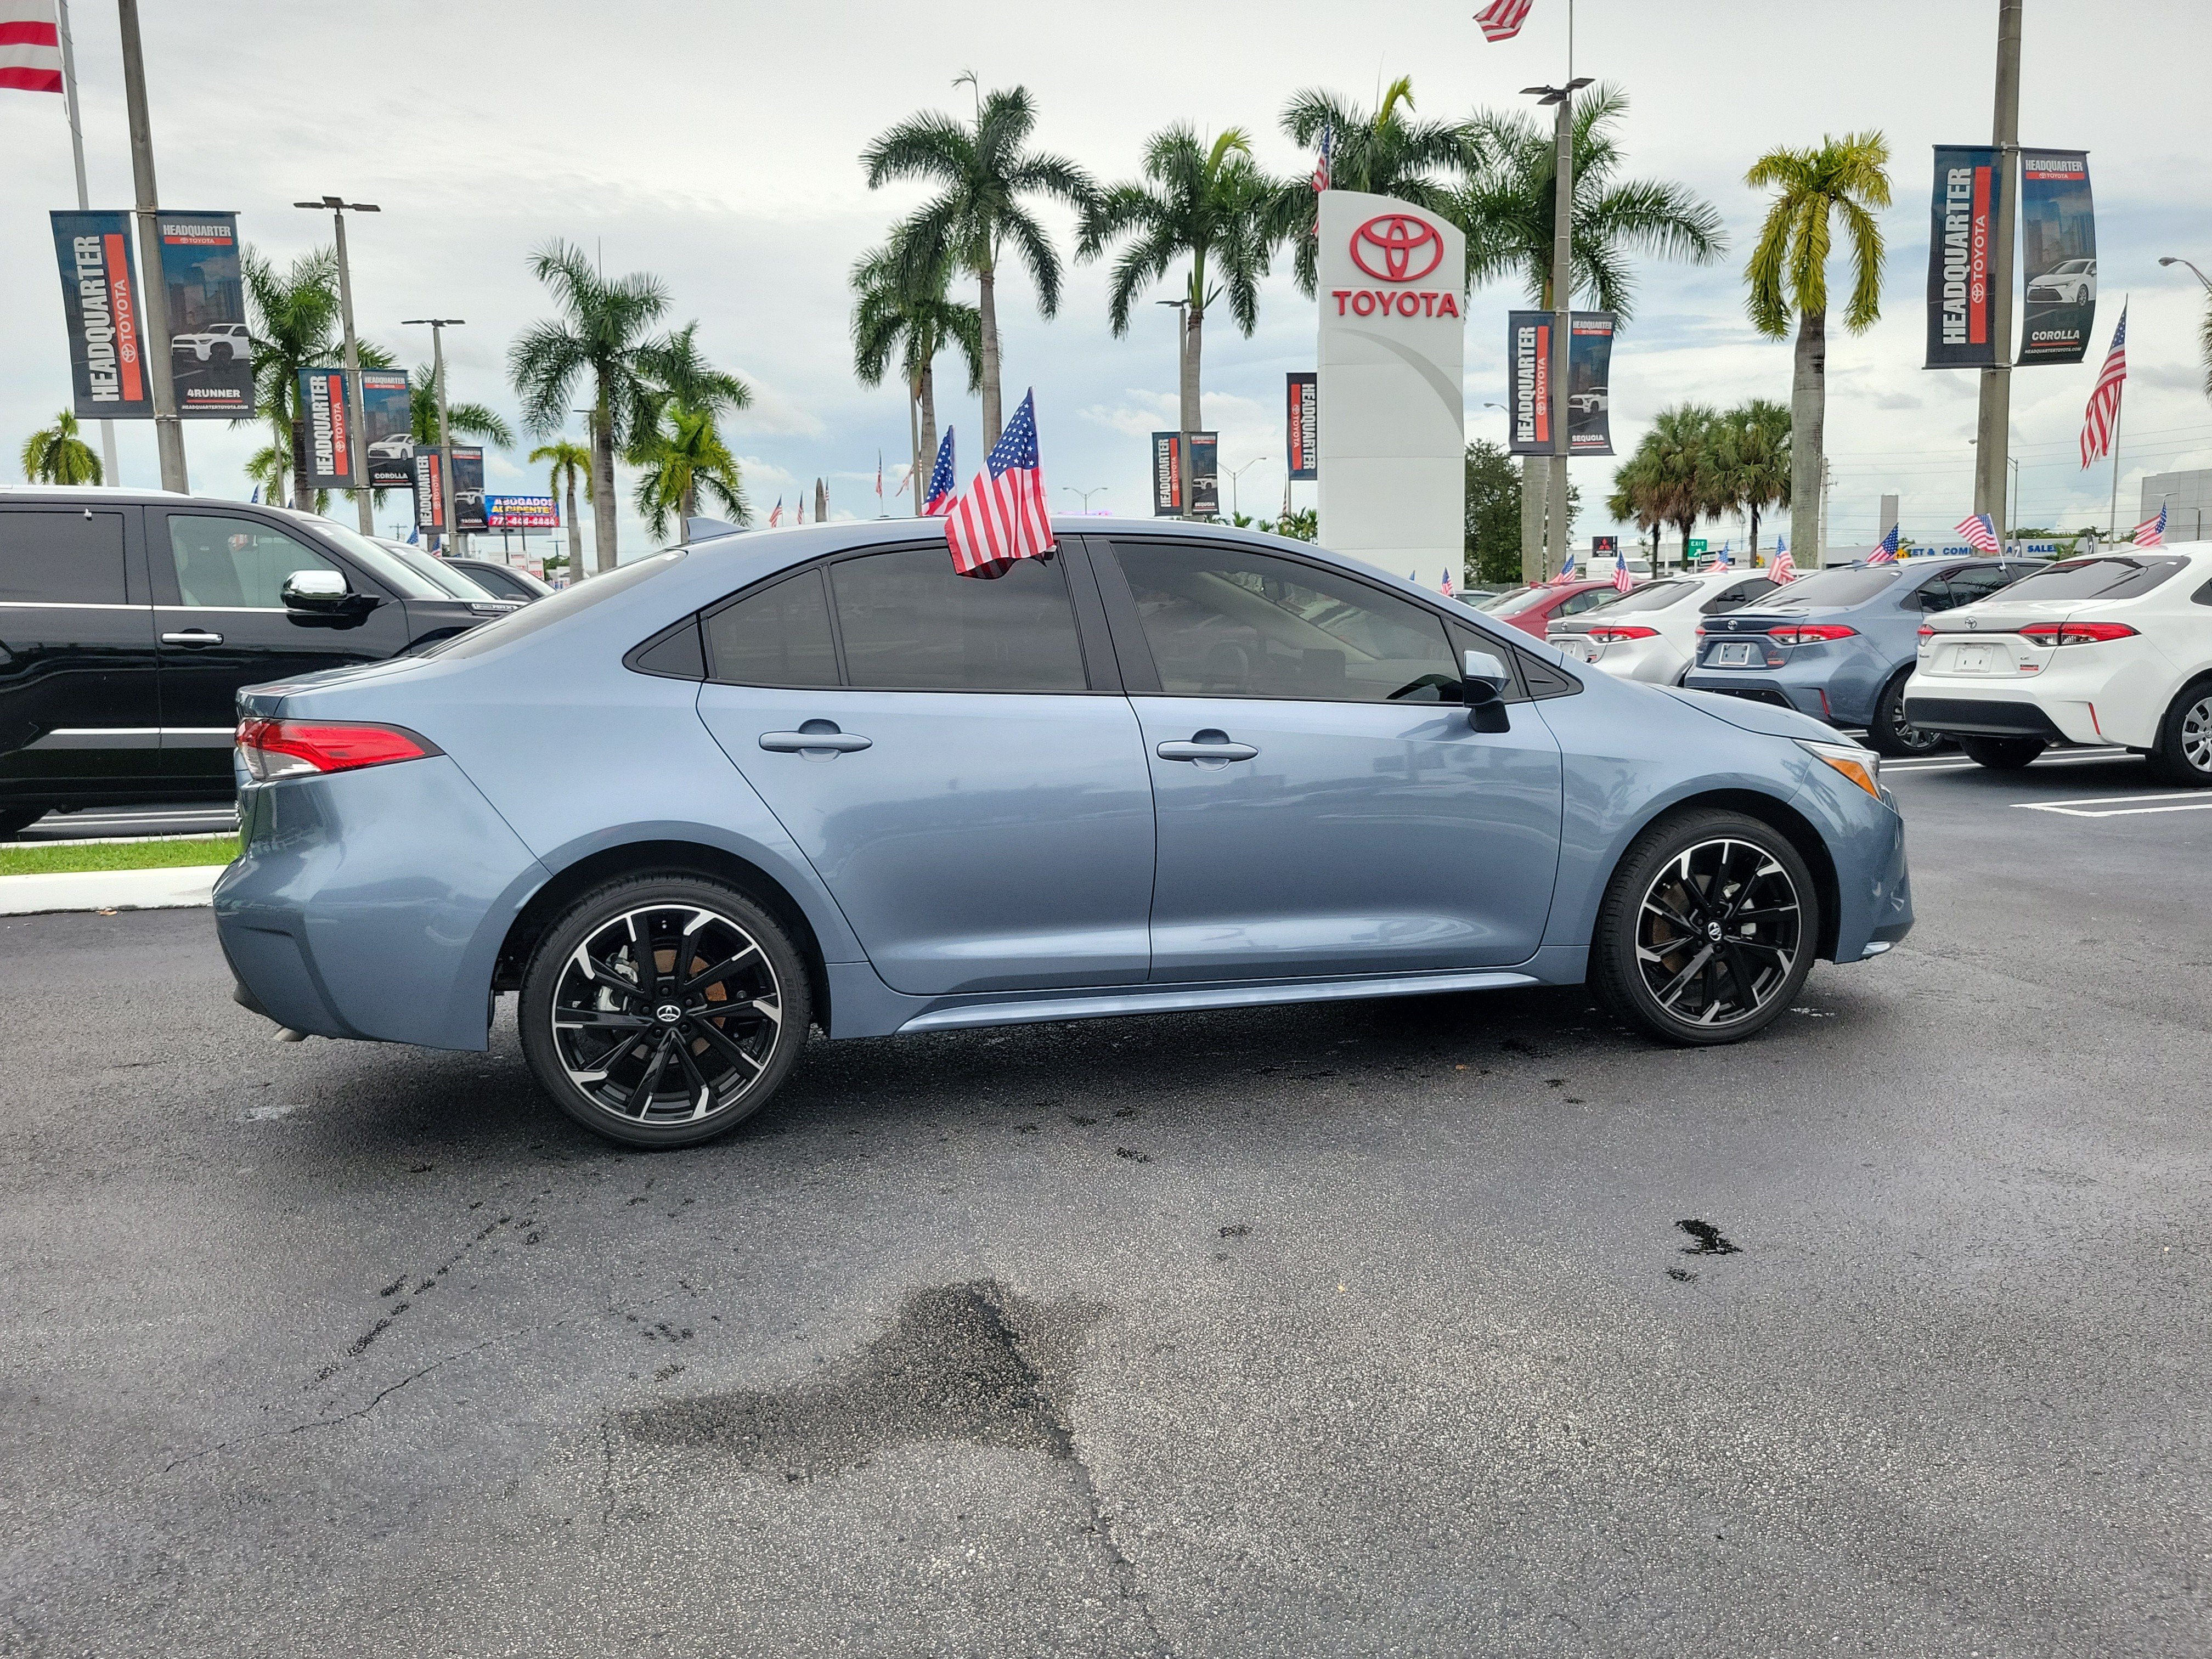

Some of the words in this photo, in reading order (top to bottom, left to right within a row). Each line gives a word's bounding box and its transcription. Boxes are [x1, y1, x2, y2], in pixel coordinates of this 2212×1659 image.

[2025, 160, 2083, 172] HEADQUARTER
[163, 224, 232, 237] HEADQUARTER
[1943, 168, 1972, 345] HEADQUARTER
[1973, 215, 1985, 281] TOYOTA
[74, 236, 120, 402] HEADQUARTER
[114, 279, 132, 341] TOYOTA
[1332, 291, 1459, 318] TOYOTA
[2032, 330, 2080, 341] COROLLA
[187, 388, 241, 398] 4RUNNER
[1517, 326, 1536, 442] HEADQUARTER
[1537, 357, 1546, 402] TOYOTA
[310, 376, 335, 475] HEADQUARTER
[334, 402, 345, 439] TOYOTA
[1300, 384, 1316, 470] HEADQUARTER
[416, 455, 433, 526] HEADQUARTER
[1158, 439, 1171, 507] HEADQUARTER
